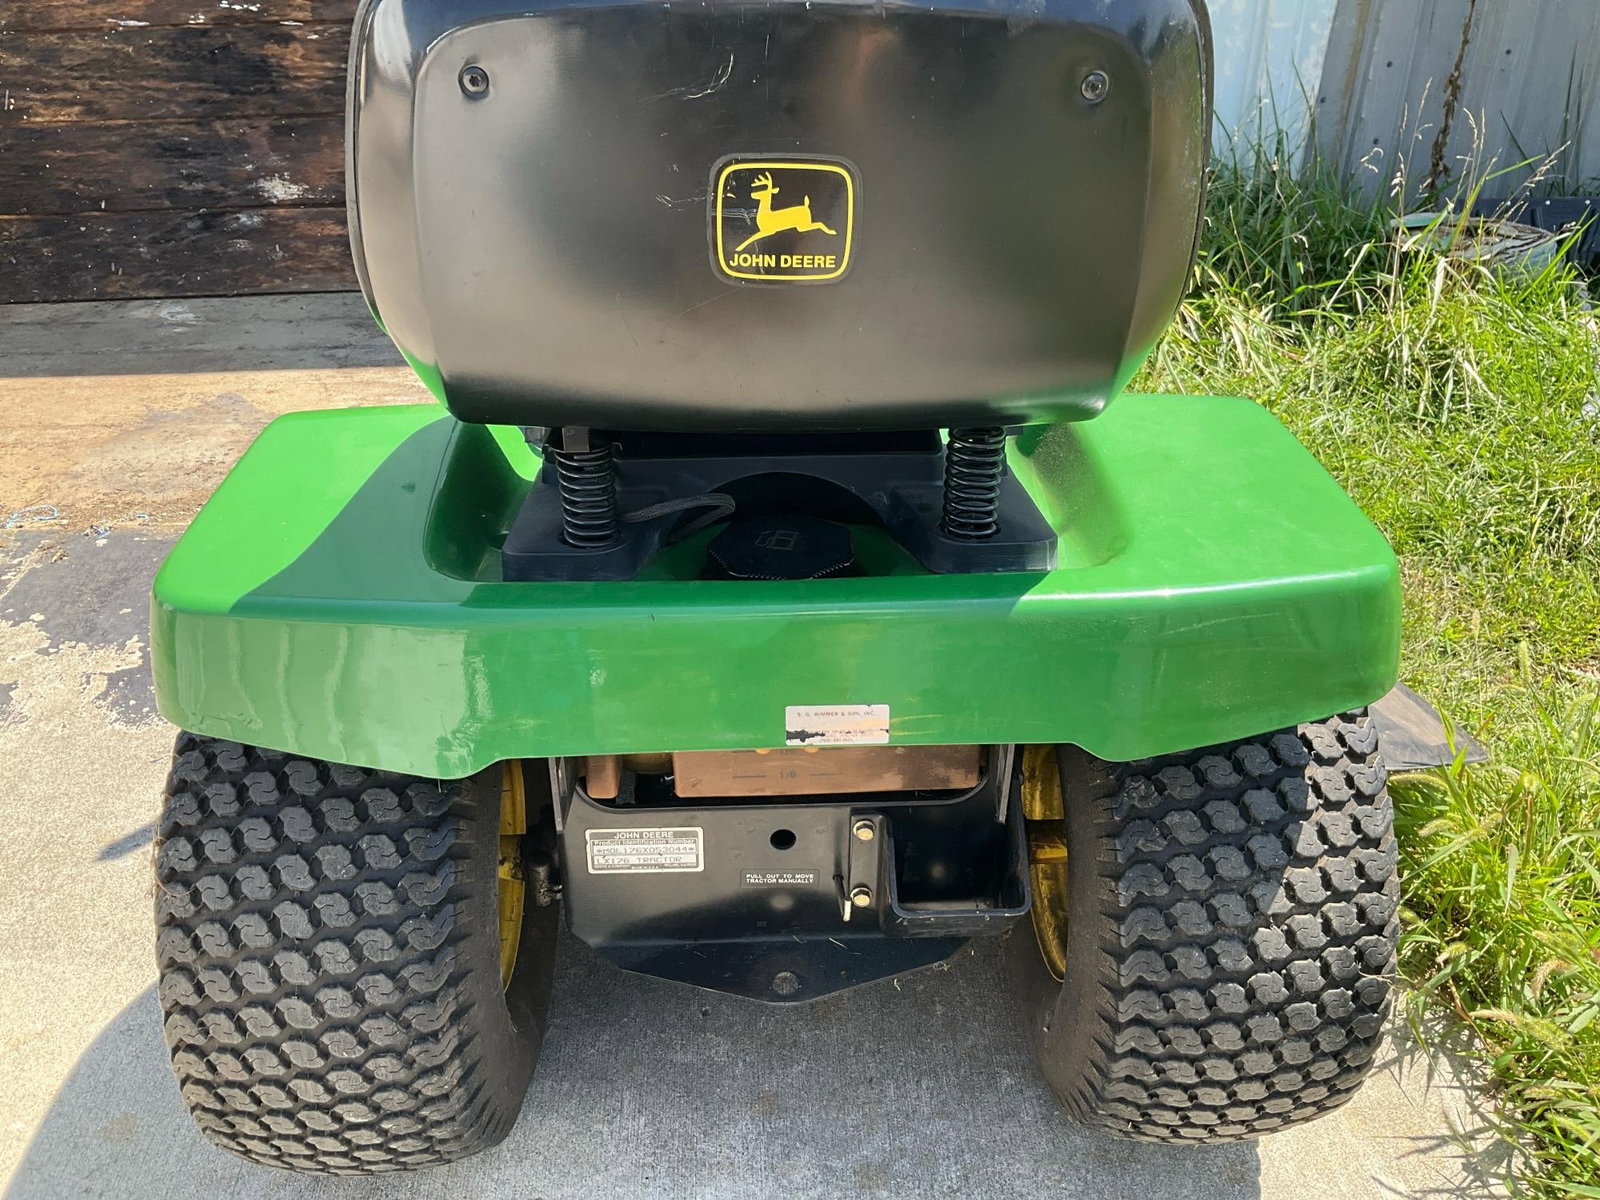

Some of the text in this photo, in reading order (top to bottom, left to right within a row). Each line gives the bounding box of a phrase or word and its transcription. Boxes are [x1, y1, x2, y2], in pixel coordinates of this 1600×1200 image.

[729, 253, 836, 268] JOHN DEERE
[642, 831, 674, 839] DEERE
